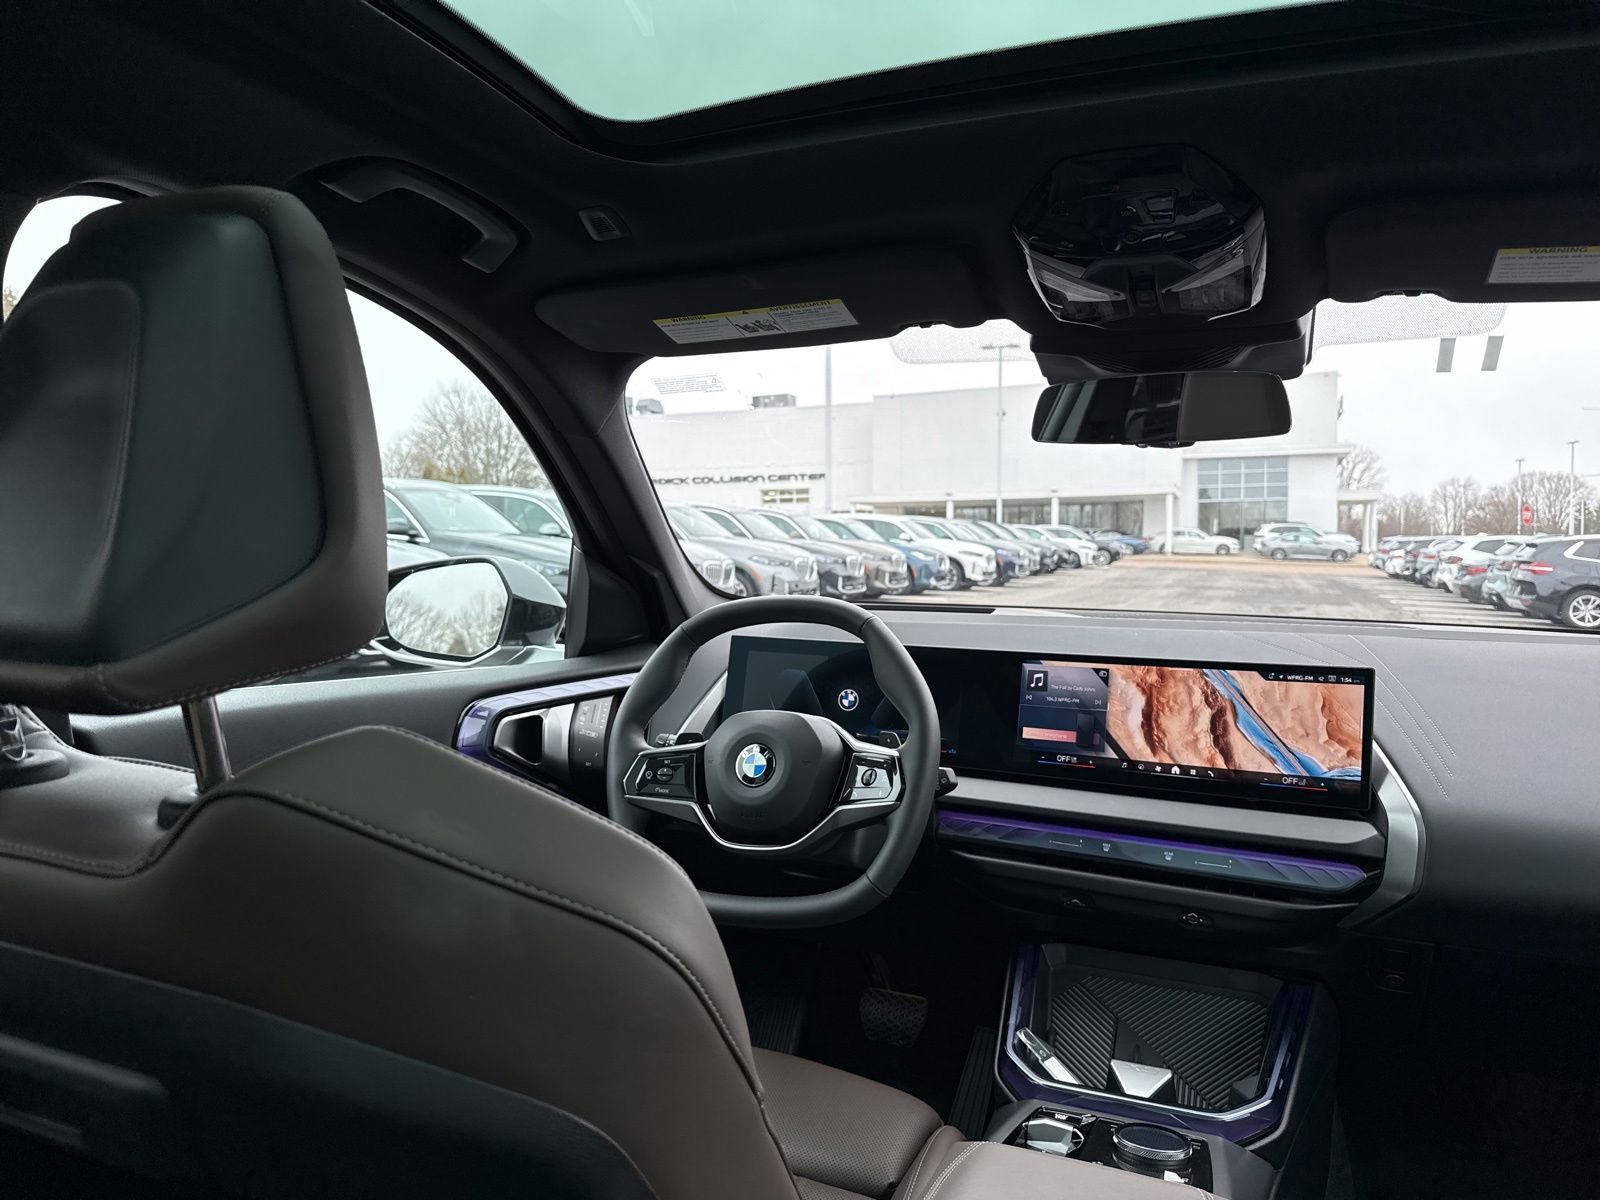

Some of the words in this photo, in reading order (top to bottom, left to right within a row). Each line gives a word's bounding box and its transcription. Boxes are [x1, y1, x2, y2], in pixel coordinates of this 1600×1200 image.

[1528, 246, 1589, 255] WARNING
[768, 300, 832, 312] AVERTISSEMENT
[691, 474, 765, 485] COLLISION
[767, 472, 826, 483] CENTER
[1056, 754, 1071, 763] OFF
[1282, 776, 1298, 785] OFF
